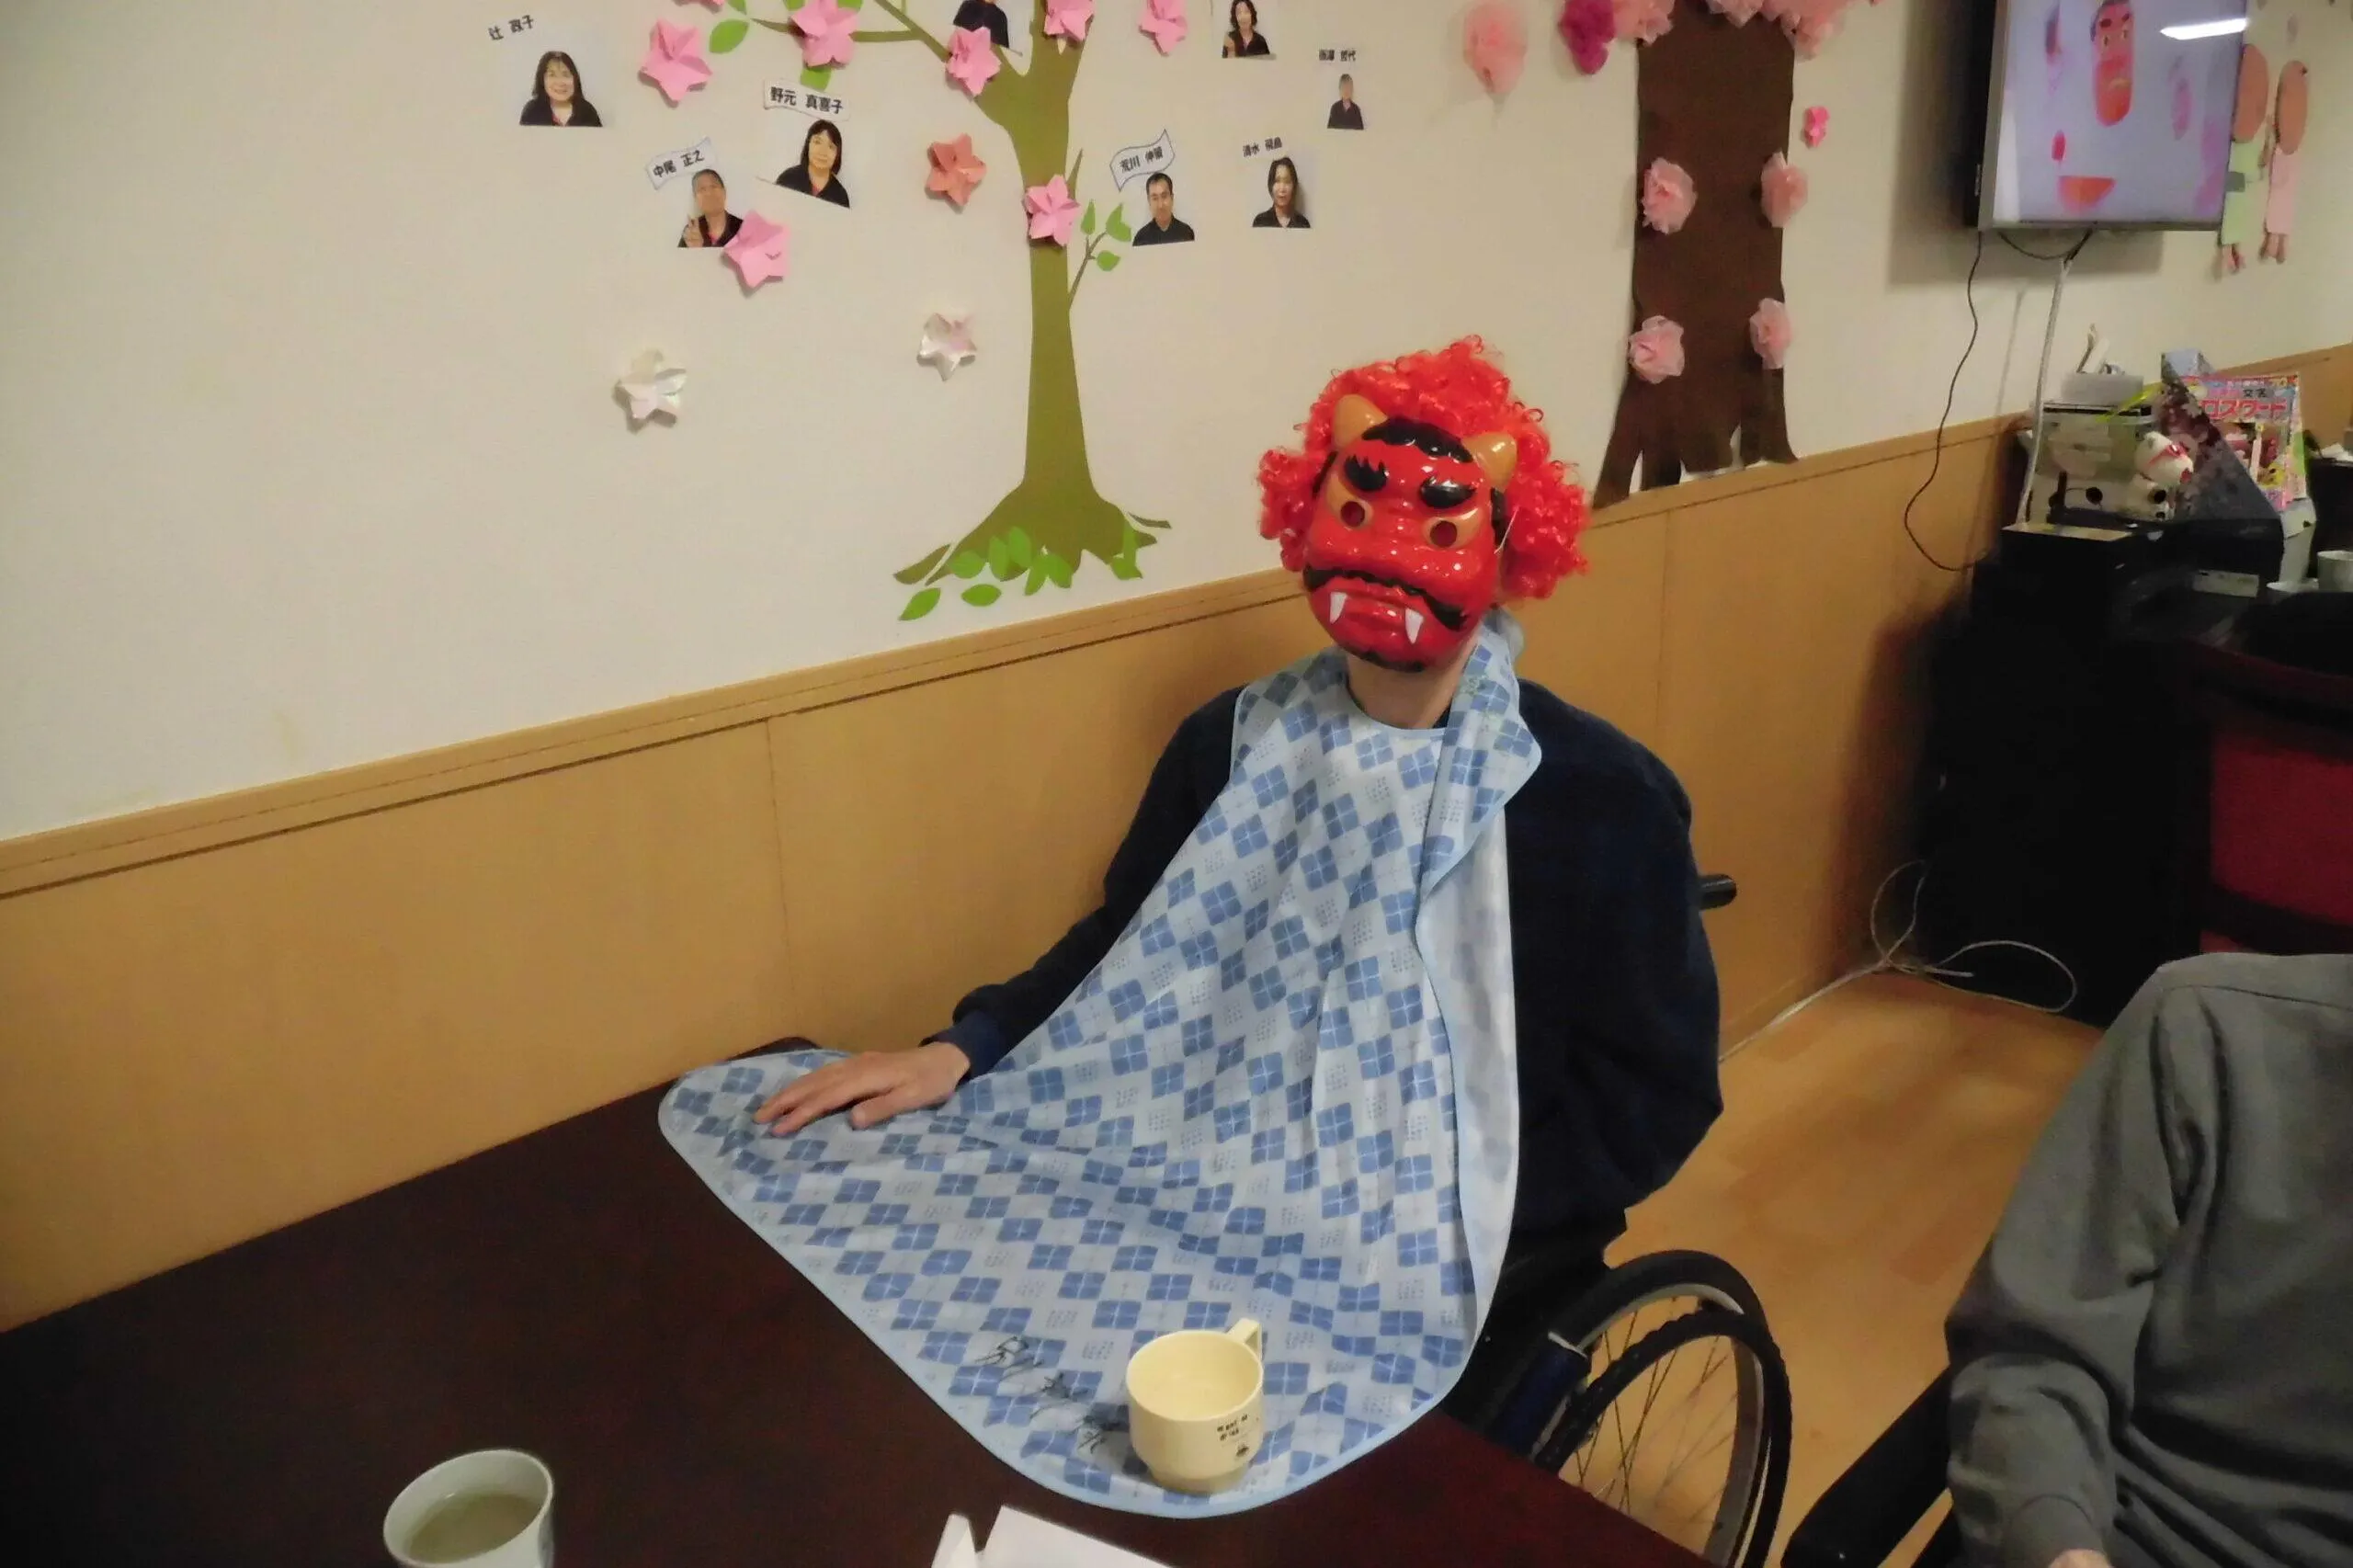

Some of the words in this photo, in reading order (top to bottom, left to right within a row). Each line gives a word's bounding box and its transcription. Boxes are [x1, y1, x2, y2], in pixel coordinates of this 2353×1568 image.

[770, 86, 797, 106] 野元
[653, 160, 676, 177] 中尾
[1120, 155, 1141, 173] 荒川
